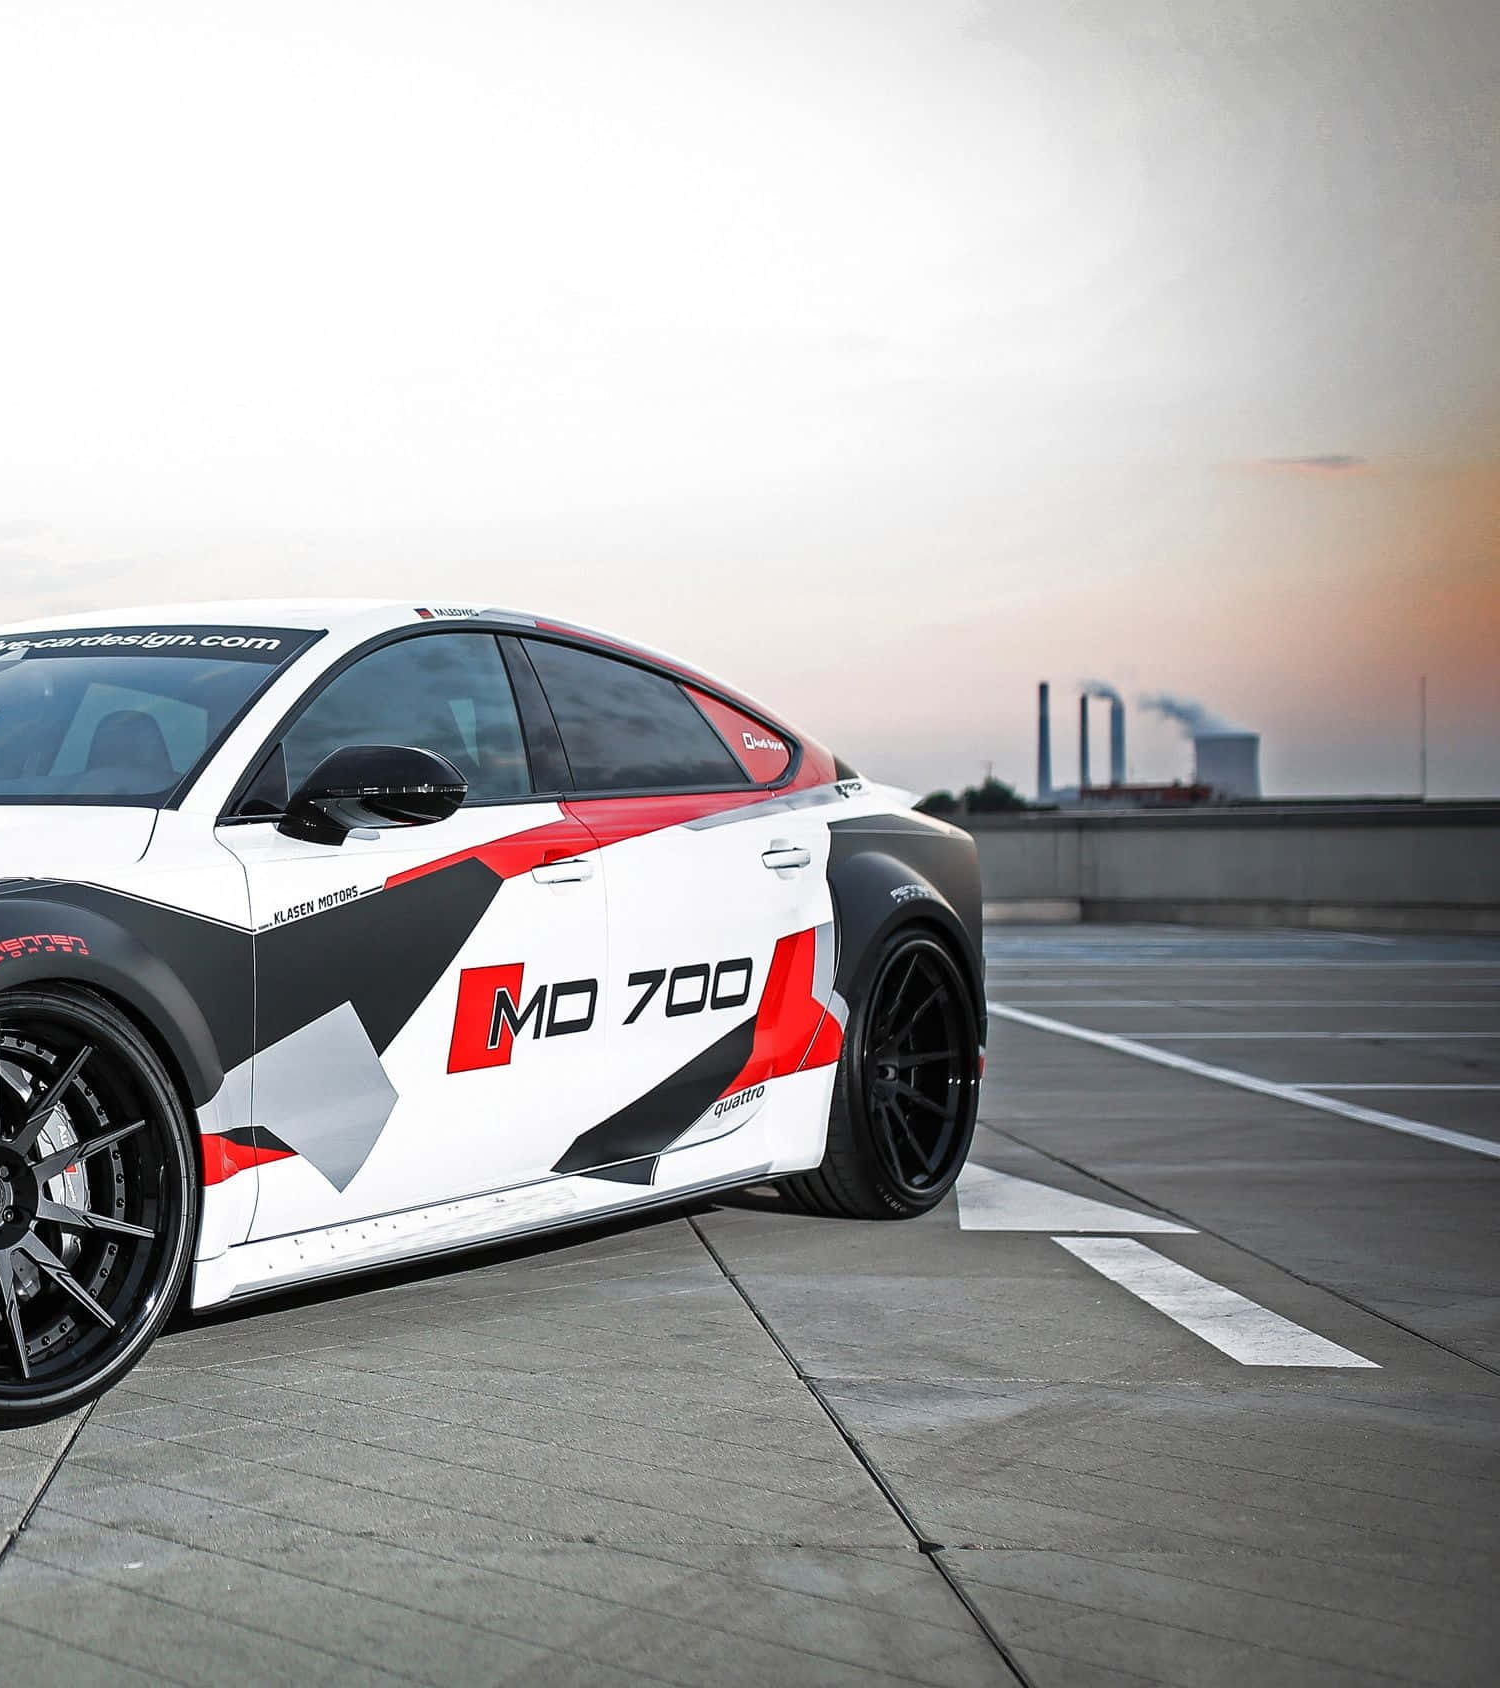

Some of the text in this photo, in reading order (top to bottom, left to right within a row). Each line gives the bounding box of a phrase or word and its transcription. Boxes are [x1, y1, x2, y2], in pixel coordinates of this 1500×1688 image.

[273, 885, 359, 925] KLASEN MOTORS
[488, 957, 753, 1048] MD 700
[713, 1084, 765, 1119] quattro
